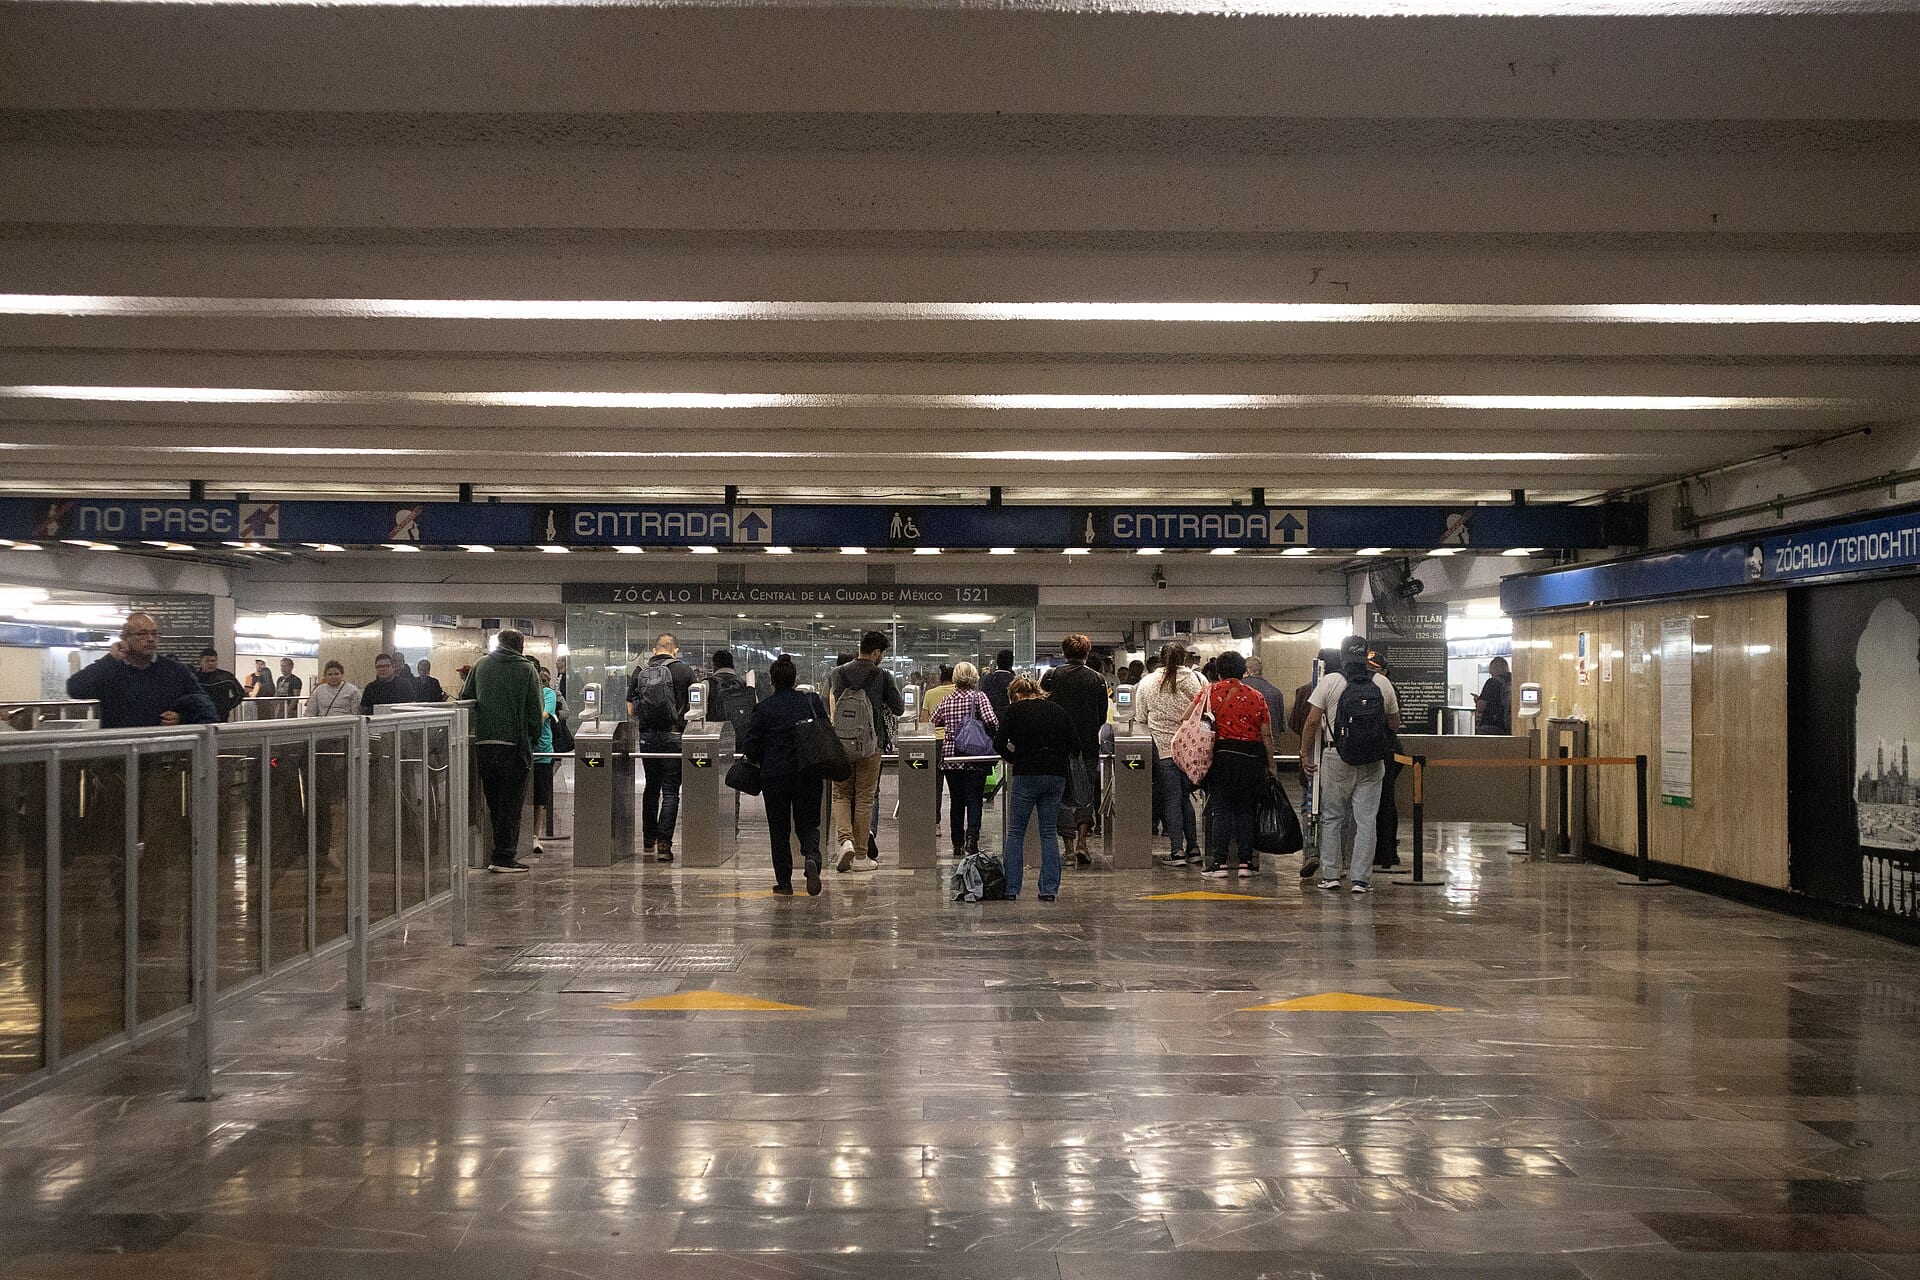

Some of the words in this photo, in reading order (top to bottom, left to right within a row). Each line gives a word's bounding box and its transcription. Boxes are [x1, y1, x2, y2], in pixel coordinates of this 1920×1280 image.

[80, 506, 125, 532] NO
[140, 507, 233, 533] PASE
[574, 511, 731, 537] ENTRADA
[1113, 514, 1267, 539] ENTRADA
[613, 586, 691, 602] ZÓCALO
[955, 588, 988, 602] 1521
